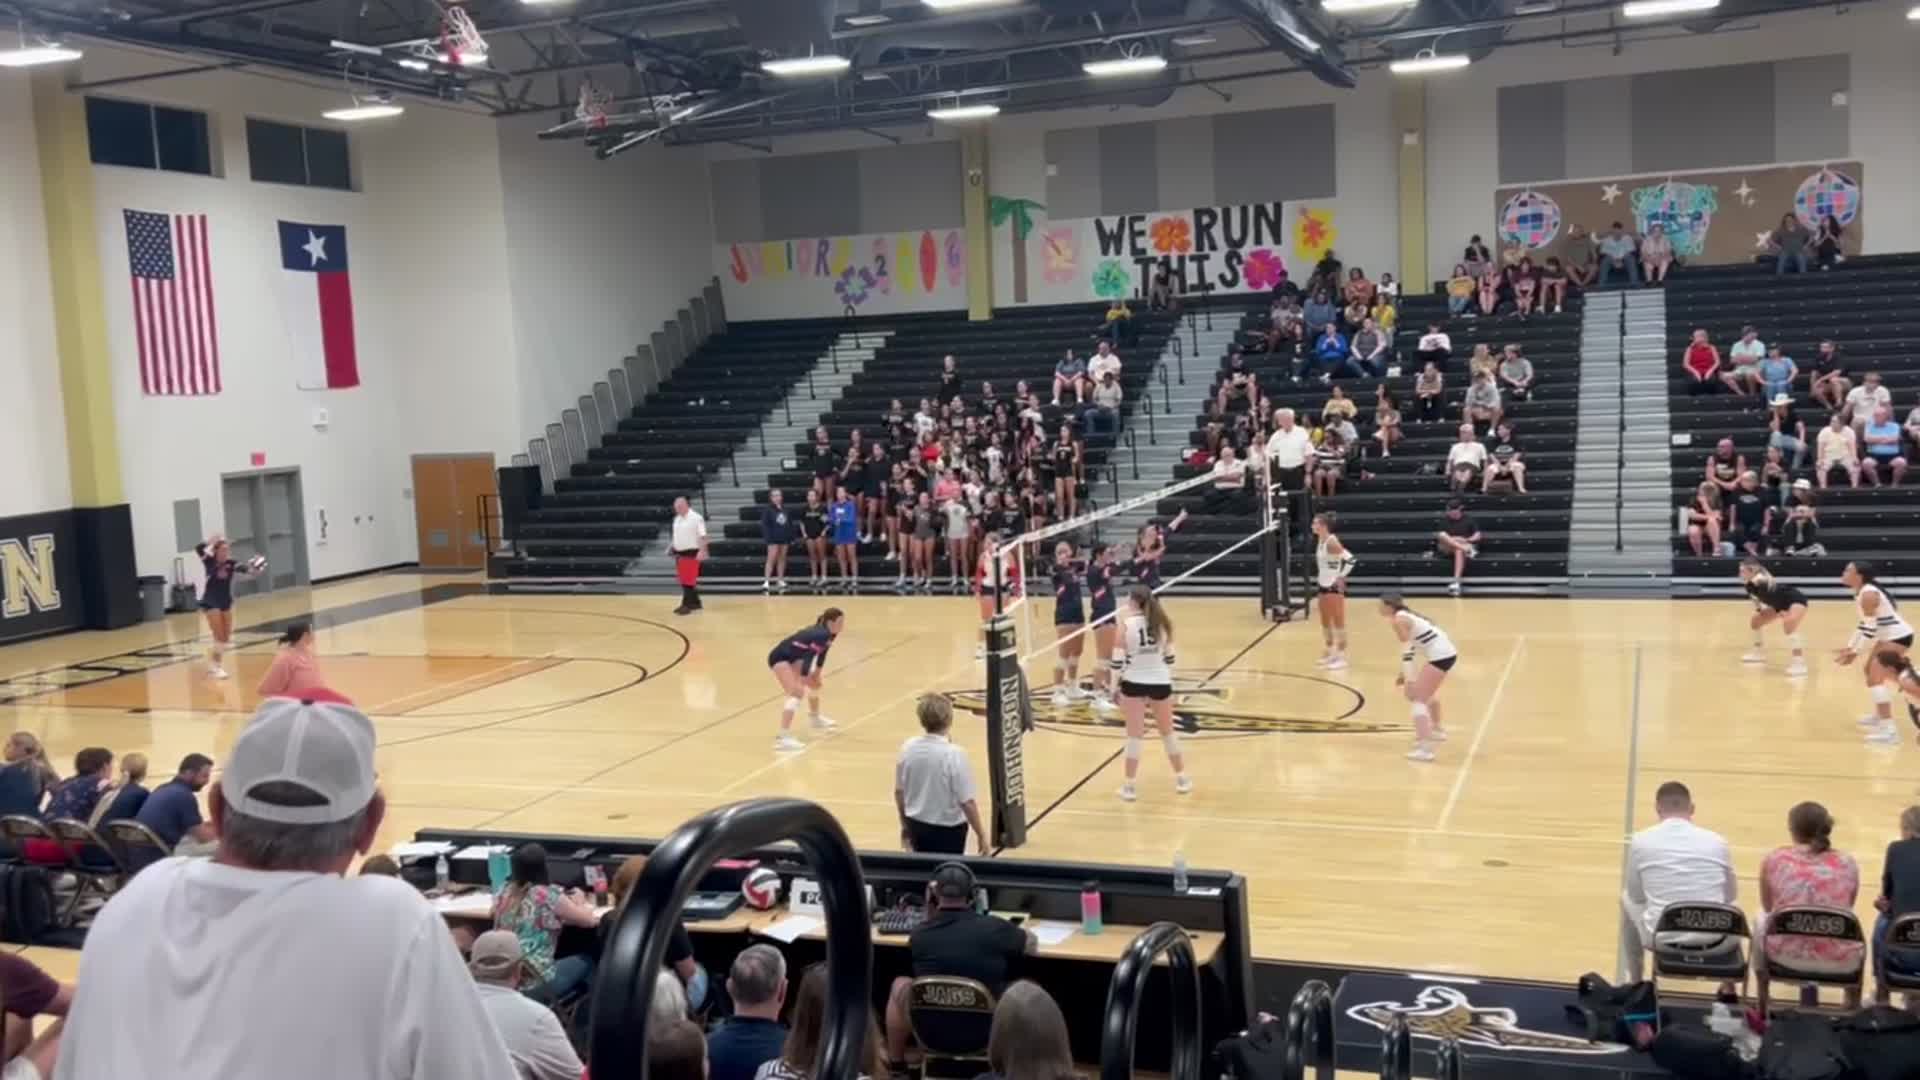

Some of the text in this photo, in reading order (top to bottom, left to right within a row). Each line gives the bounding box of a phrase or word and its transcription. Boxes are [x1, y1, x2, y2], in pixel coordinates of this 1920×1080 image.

[1095, 202, 1282, 257] WE RUN
[1133, 249, 1243, 298] THIS
[0, 533, 61, 618] N
[1000, 673, 1025, 806] JOHNSON
[1676, 909, 1733, 929] JAGS
[1785, 912, 1846, 936] JAGS
[922, 985, 977, 1006] JAGS
